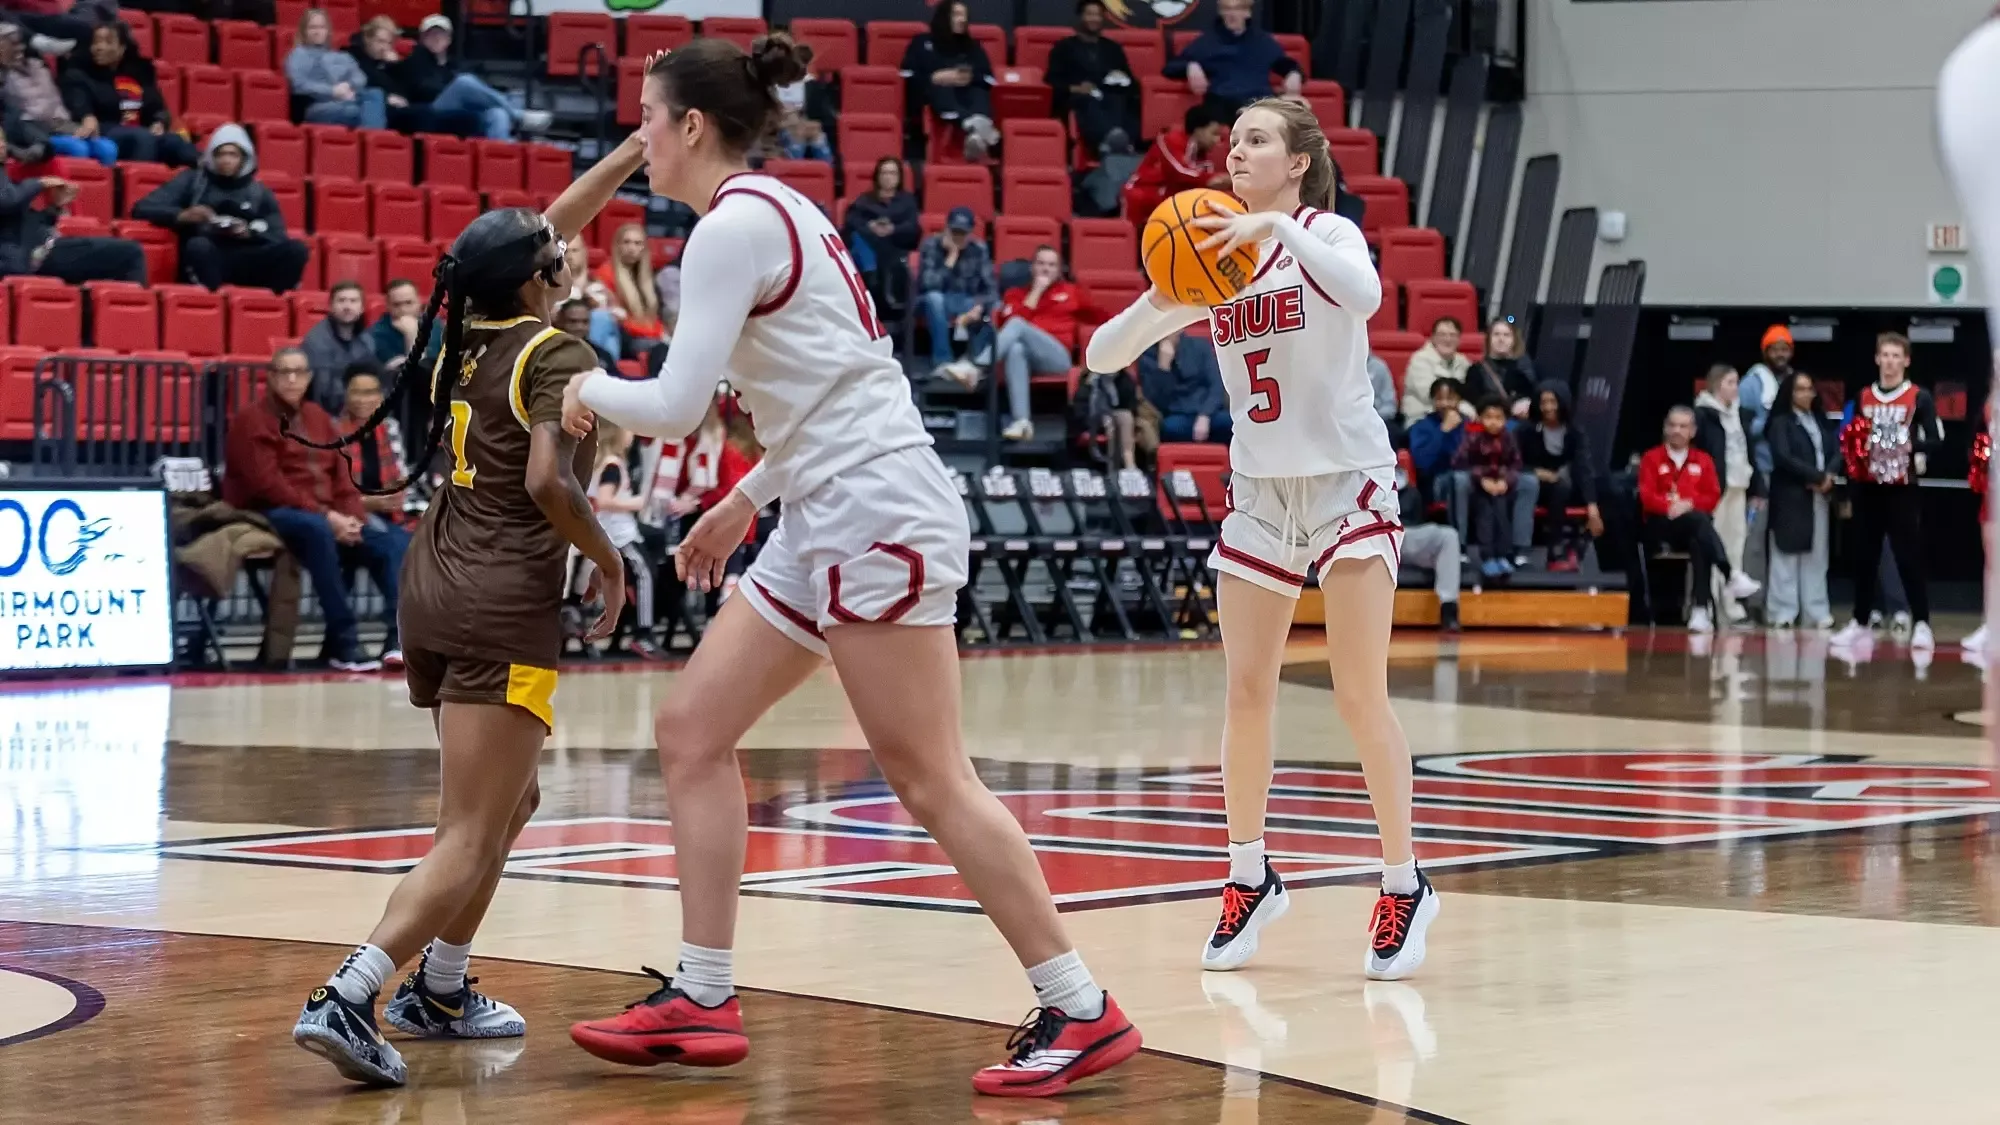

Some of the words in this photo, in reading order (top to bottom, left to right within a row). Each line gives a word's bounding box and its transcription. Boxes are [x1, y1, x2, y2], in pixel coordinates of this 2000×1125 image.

[1934, 225, 1960, 248] EXIT
[1209, 285, 1305, 346] SIUE
[1243, 348, 1281, 423] 5
[446, 400, 477, 490] 1
[0, 589, 146, 617] IRMOUNT
[17, 623, 94, 649] PARK
